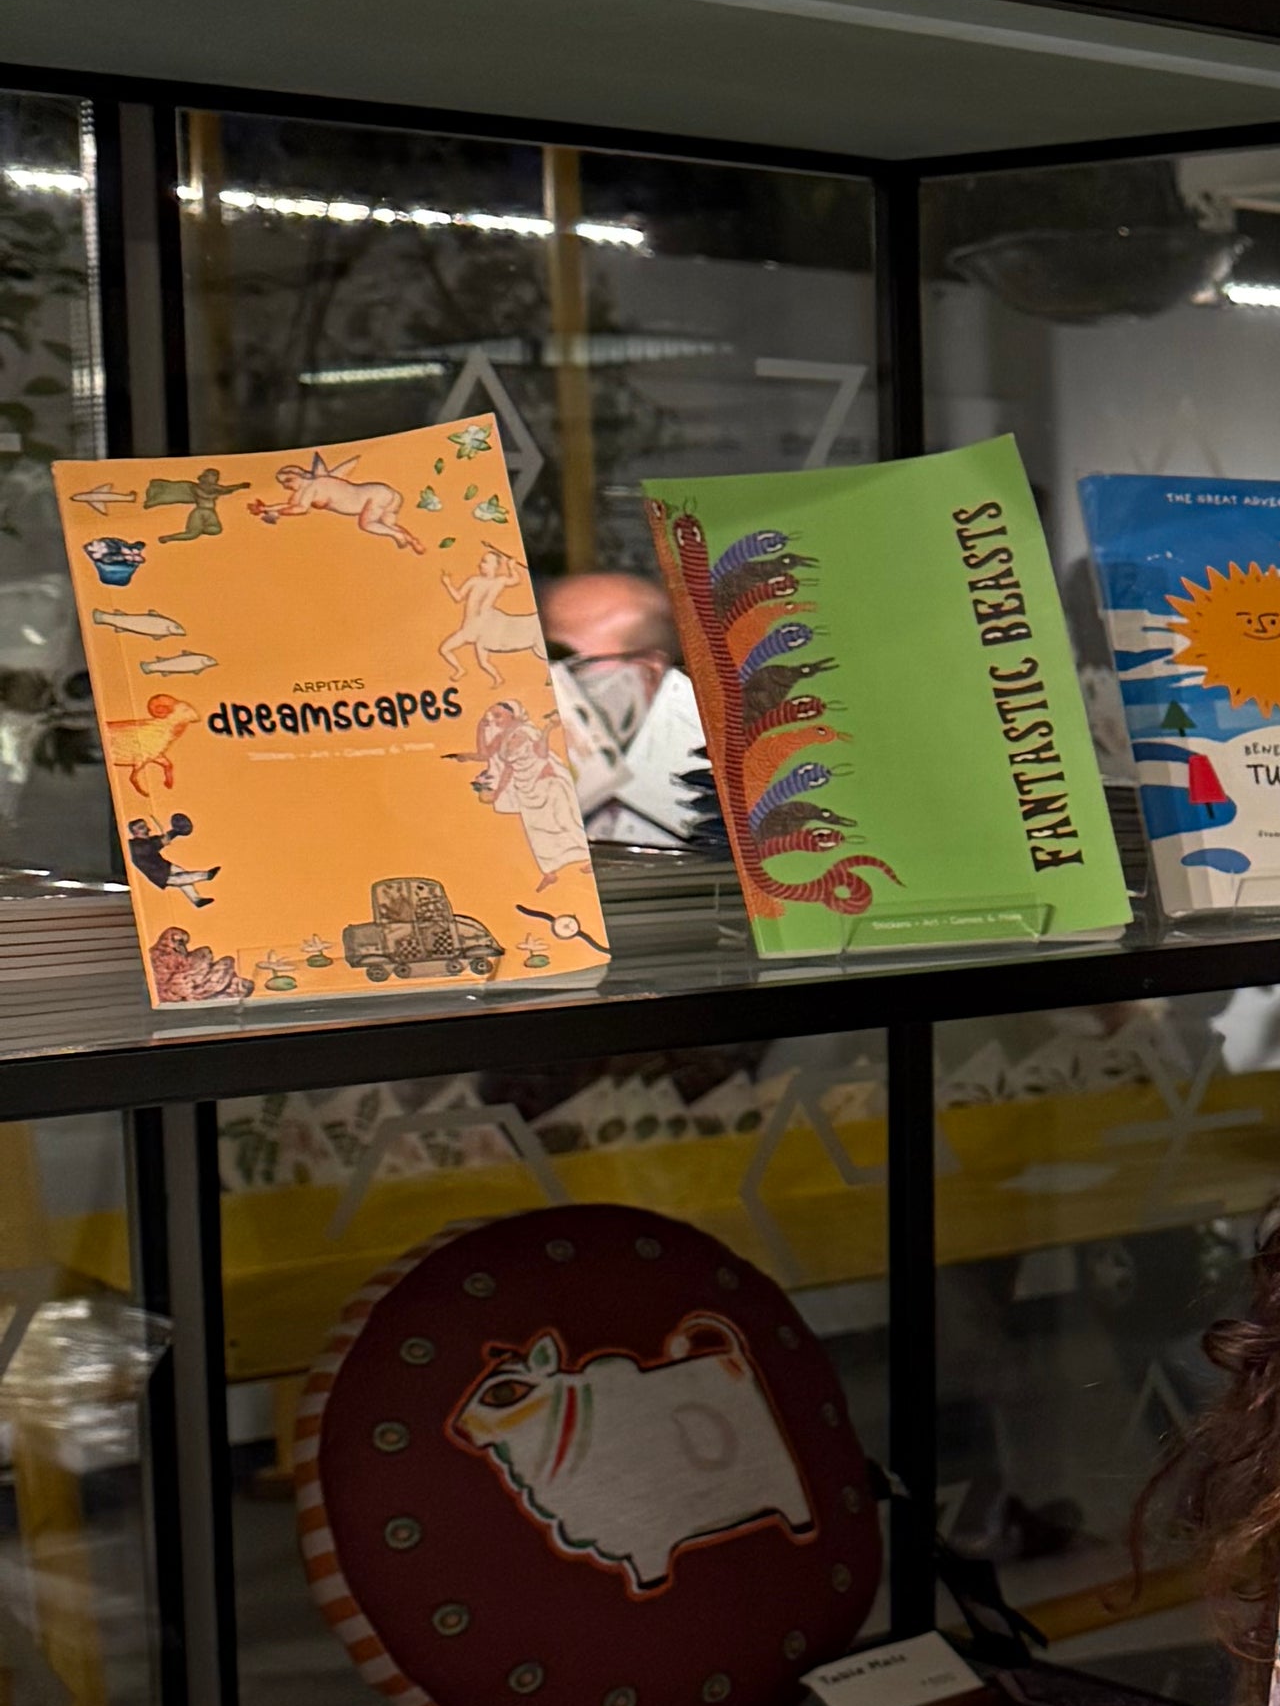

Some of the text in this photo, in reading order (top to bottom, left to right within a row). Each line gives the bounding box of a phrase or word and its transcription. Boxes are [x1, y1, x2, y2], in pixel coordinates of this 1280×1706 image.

[293, 678, 365, 693] ARPITA'S
[952, 501, 1085, 873] FANTASTIC BEASTS
